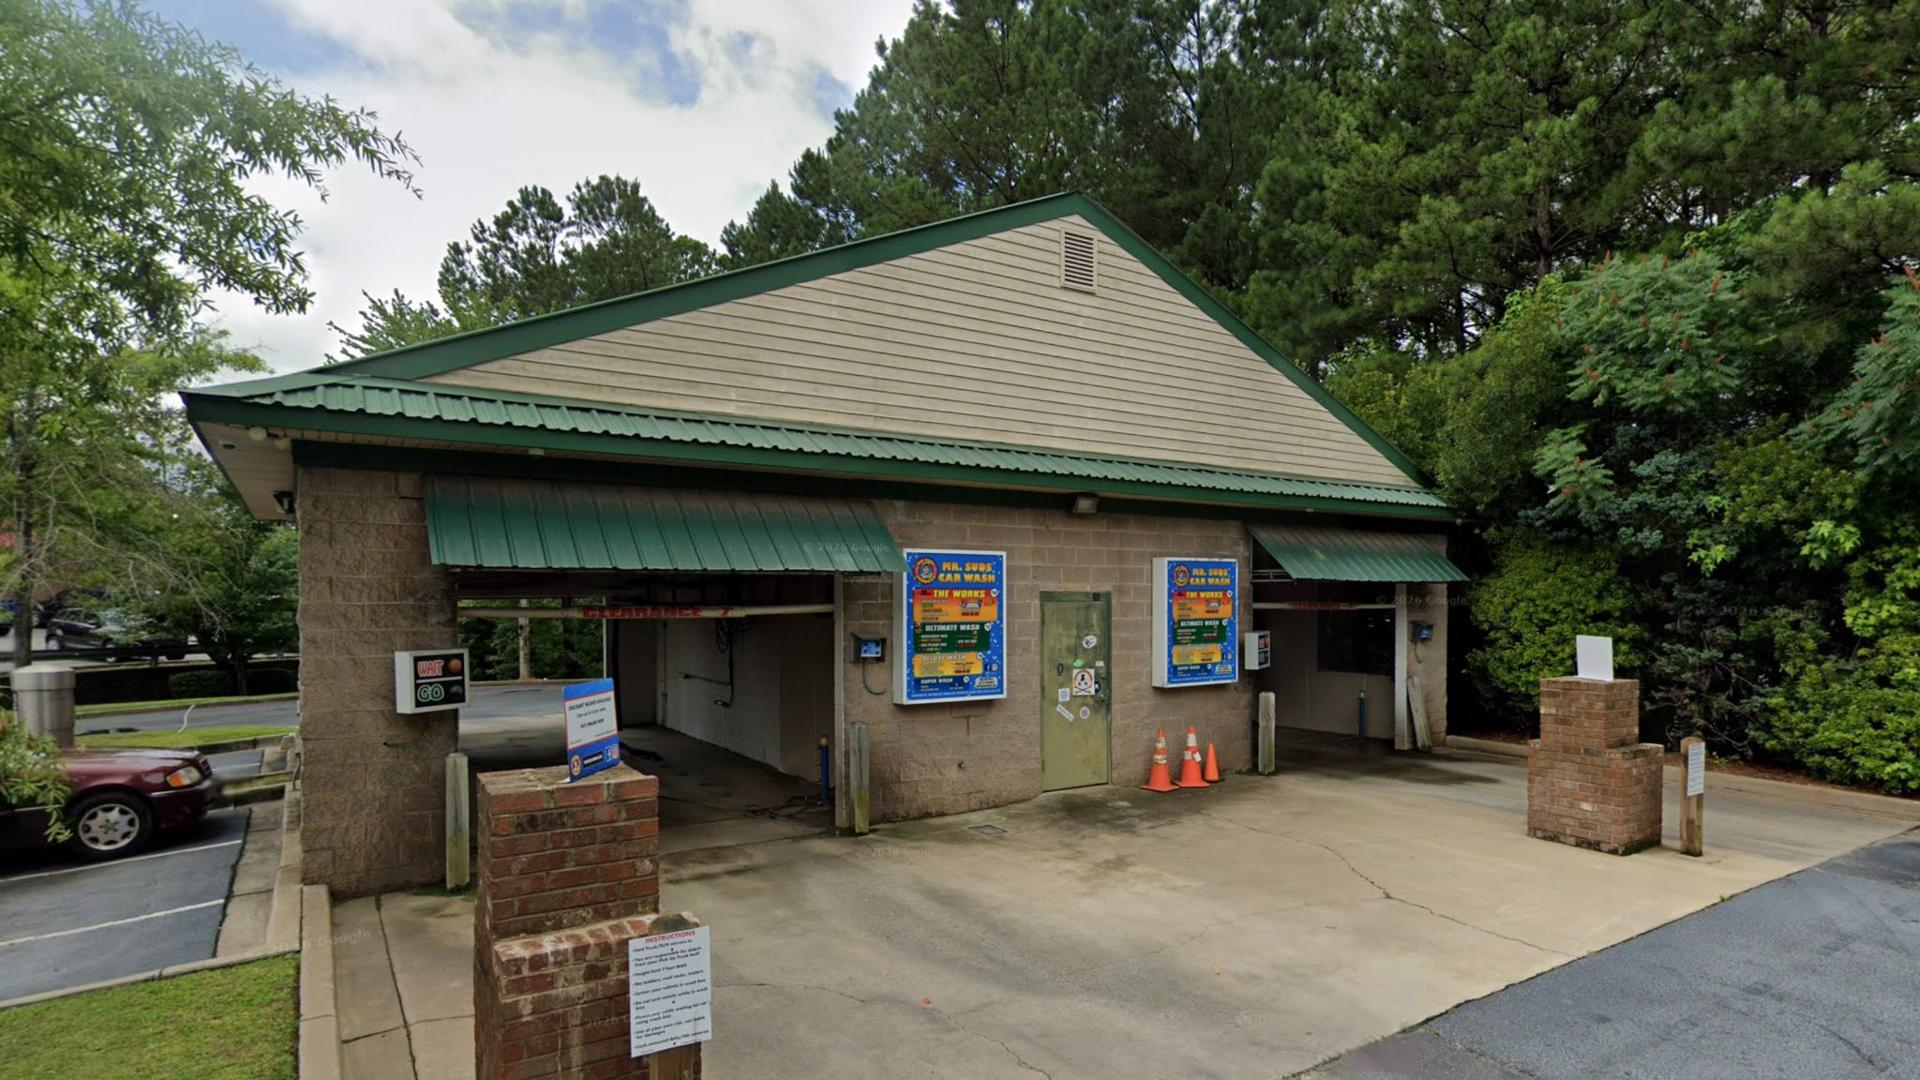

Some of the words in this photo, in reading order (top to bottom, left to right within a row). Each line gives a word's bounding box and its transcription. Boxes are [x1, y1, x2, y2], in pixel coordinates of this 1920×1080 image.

[942, 562, 962, 571] MR.
[965, 562, 992, 571] SUDS
[938, 573, 961, 583] CAR
[964, 573, 995, 582] WASH
[933, 589, 950, 598] THE
[952, 589, 985, 598] WORKS
[582, 606, 703, 618] CLEARANCE
[417, 660, 444, 677] WAIT
[417, 683, 445, 702] GO
[645, 930, 696, 943] INSTRUCTIONS
